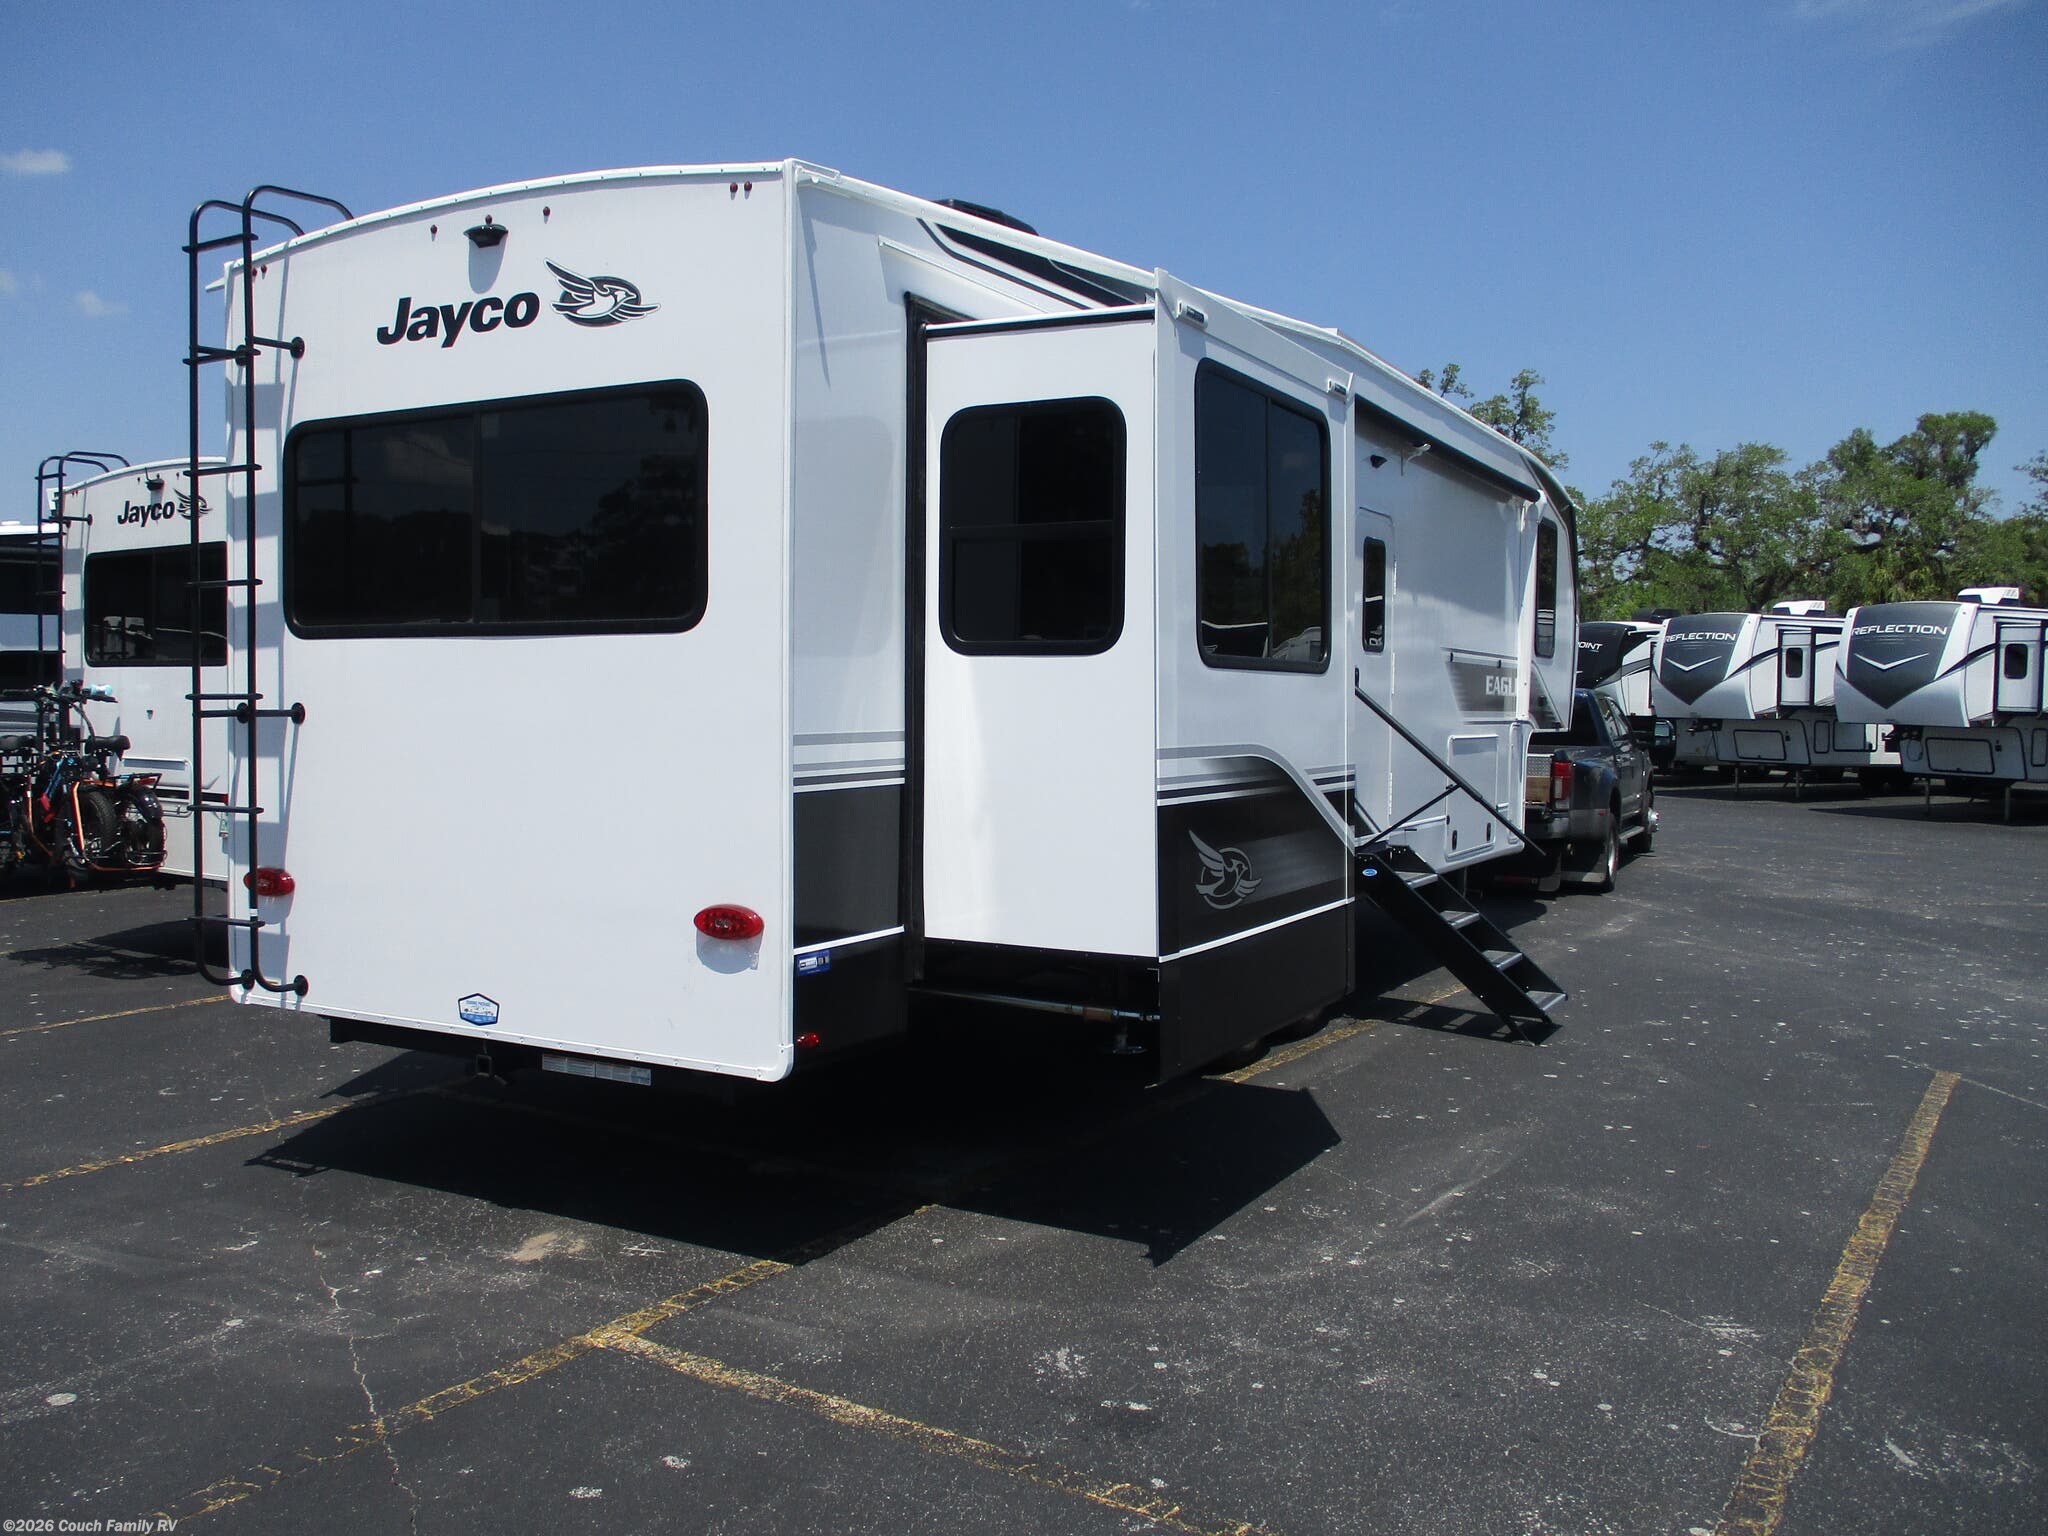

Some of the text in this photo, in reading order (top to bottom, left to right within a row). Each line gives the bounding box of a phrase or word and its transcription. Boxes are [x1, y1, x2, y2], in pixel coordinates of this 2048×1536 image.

[377, 291, 540, 348] Jayco
[117, 501, 175, 527] Jayco
[1665, 632, 1736, 643] REFLECTION
[1852, 624, 1947, 636] REFLECTION
[1486, 675, 1517, 696] EAGL
